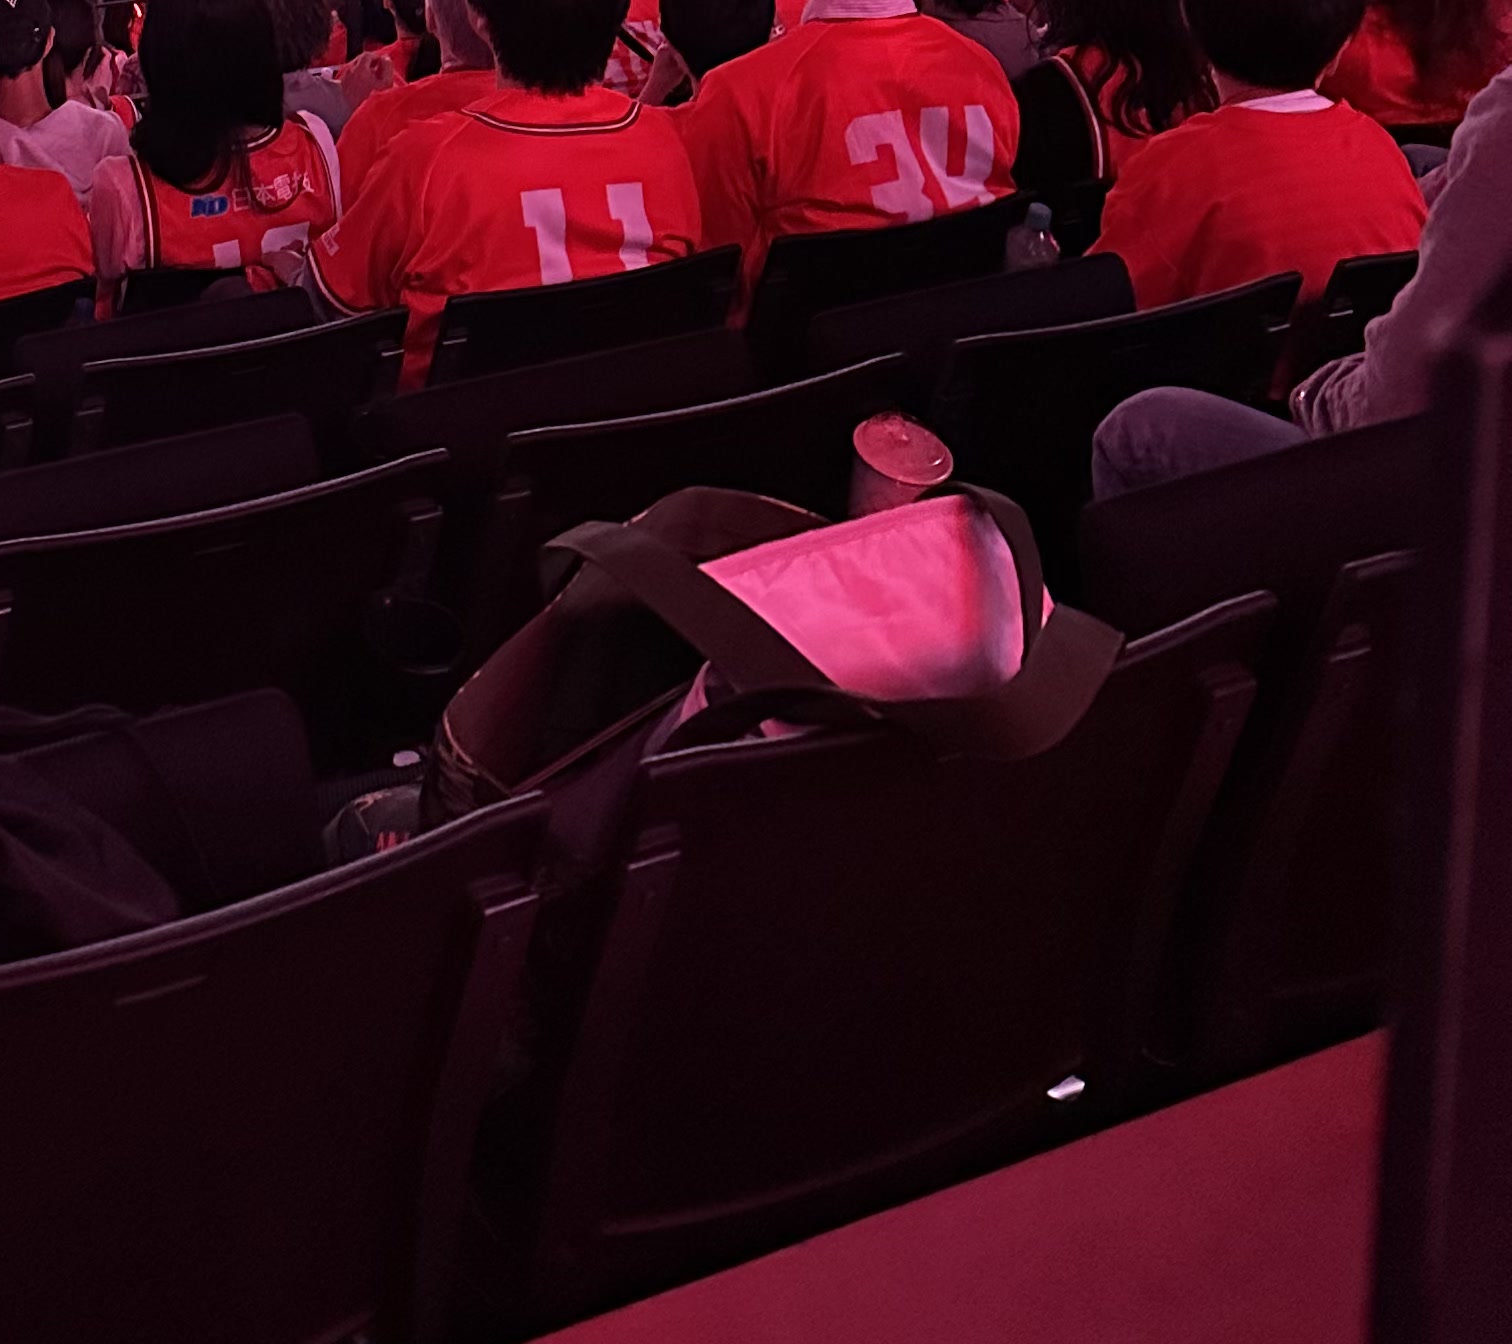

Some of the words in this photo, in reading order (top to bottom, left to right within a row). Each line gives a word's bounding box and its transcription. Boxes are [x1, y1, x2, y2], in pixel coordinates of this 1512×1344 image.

[232, 169, 315, 212] 日本電技
[520, 182, 652, 286] 11
